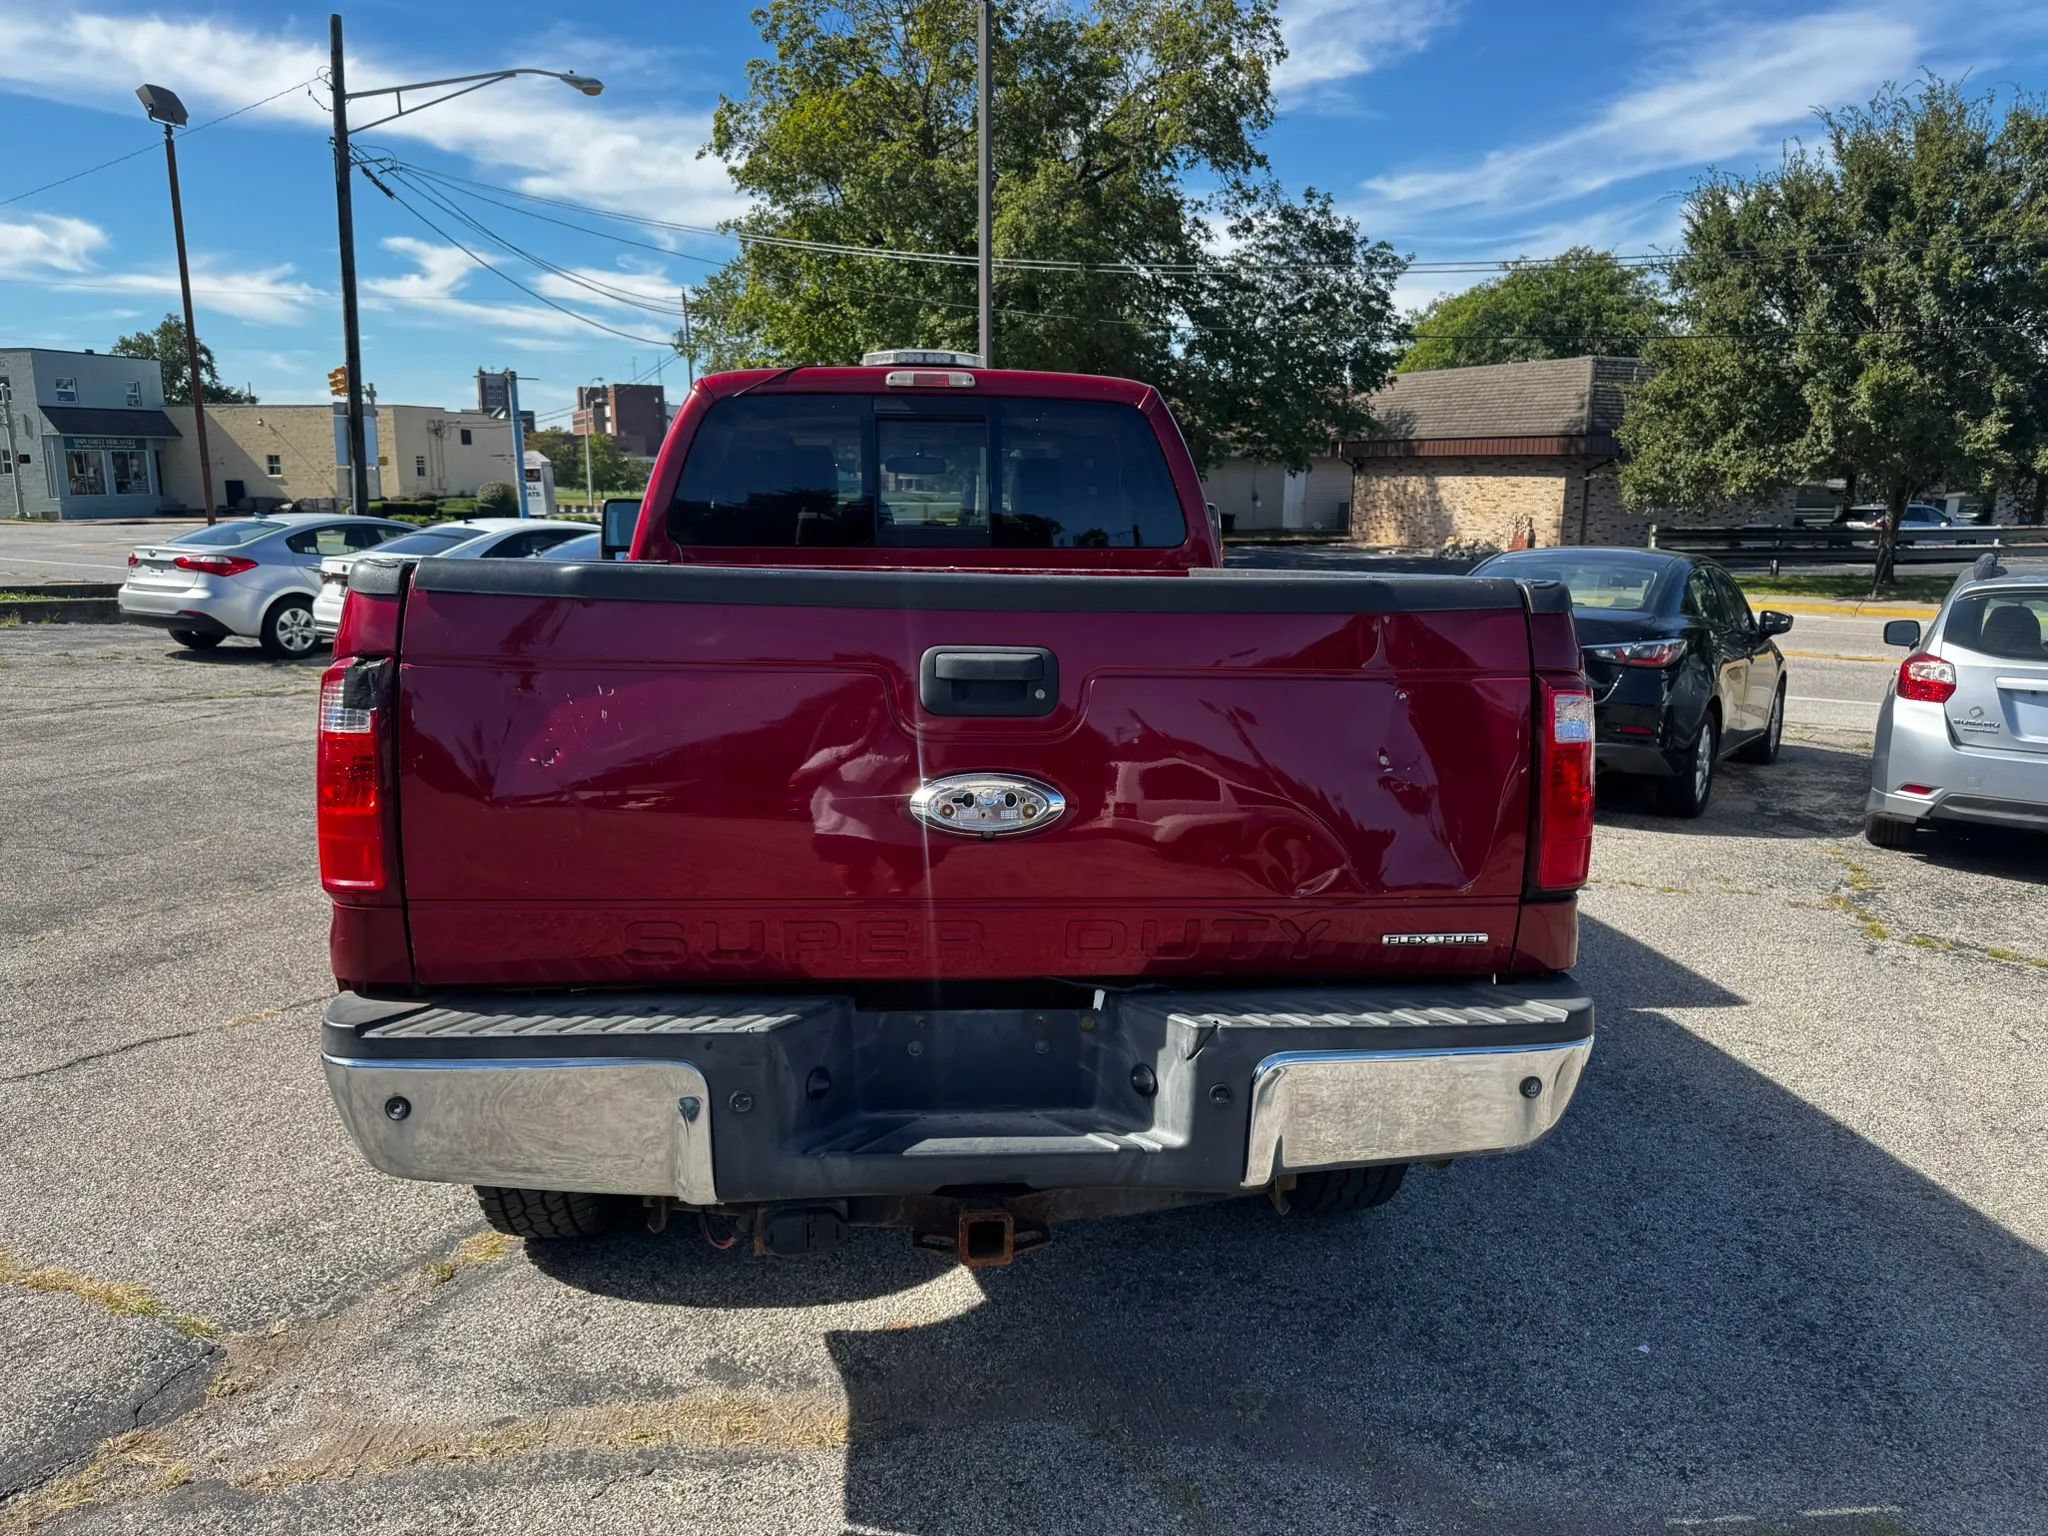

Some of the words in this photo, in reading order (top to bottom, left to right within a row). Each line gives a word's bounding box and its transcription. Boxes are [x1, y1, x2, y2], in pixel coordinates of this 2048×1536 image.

[624, 920, 985, 965] SUPER
[1065, 918, 1332, 960] DUTY
[1387, 935, 1429, 945] FLEX
[1442, 934, 1485, 944] FUEL
